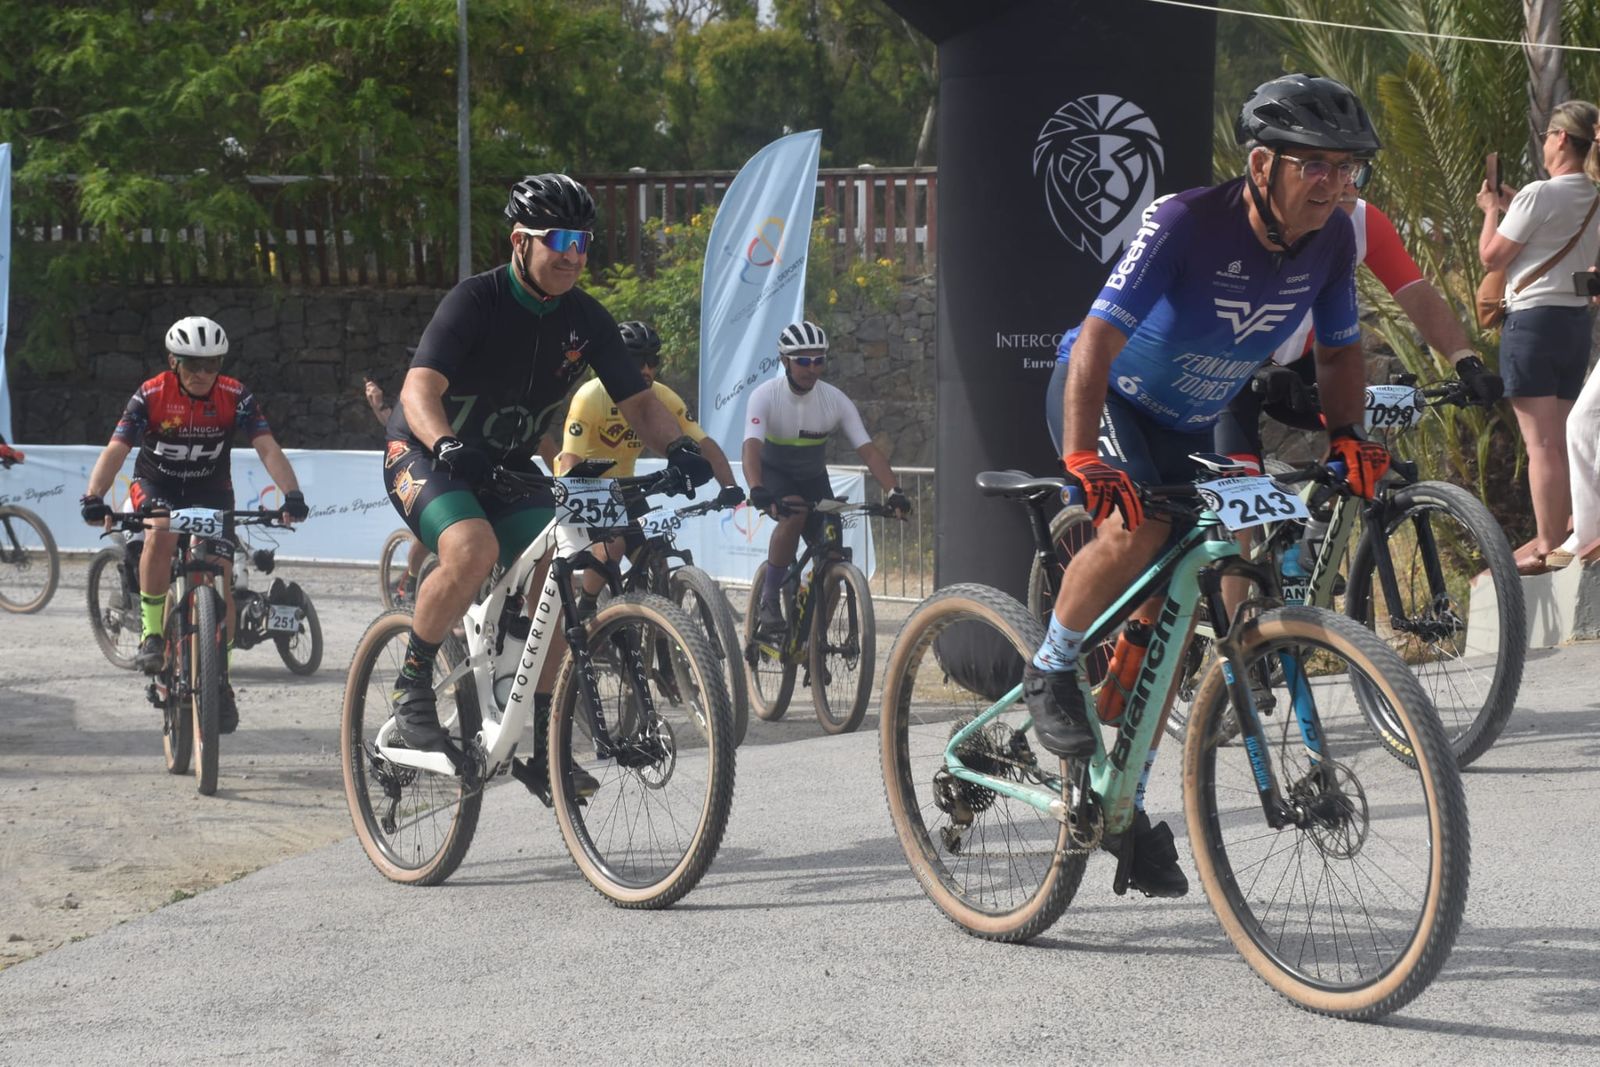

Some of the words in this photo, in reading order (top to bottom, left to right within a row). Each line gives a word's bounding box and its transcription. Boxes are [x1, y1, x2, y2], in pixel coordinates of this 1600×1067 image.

[1023, 357, 1058, 369] Euro
[747, 373, 758, 385] es
[1171, 371, 1236, 401] TORRES
[153, 440, 225, 462] BH
[569, 498, 618, 523] 254
[1229, 492, 1296, 524] 243
[179, 516, 216, 534] 253
[651, 516, 681, 534] 249
[273, 618, 295, 629] 251
